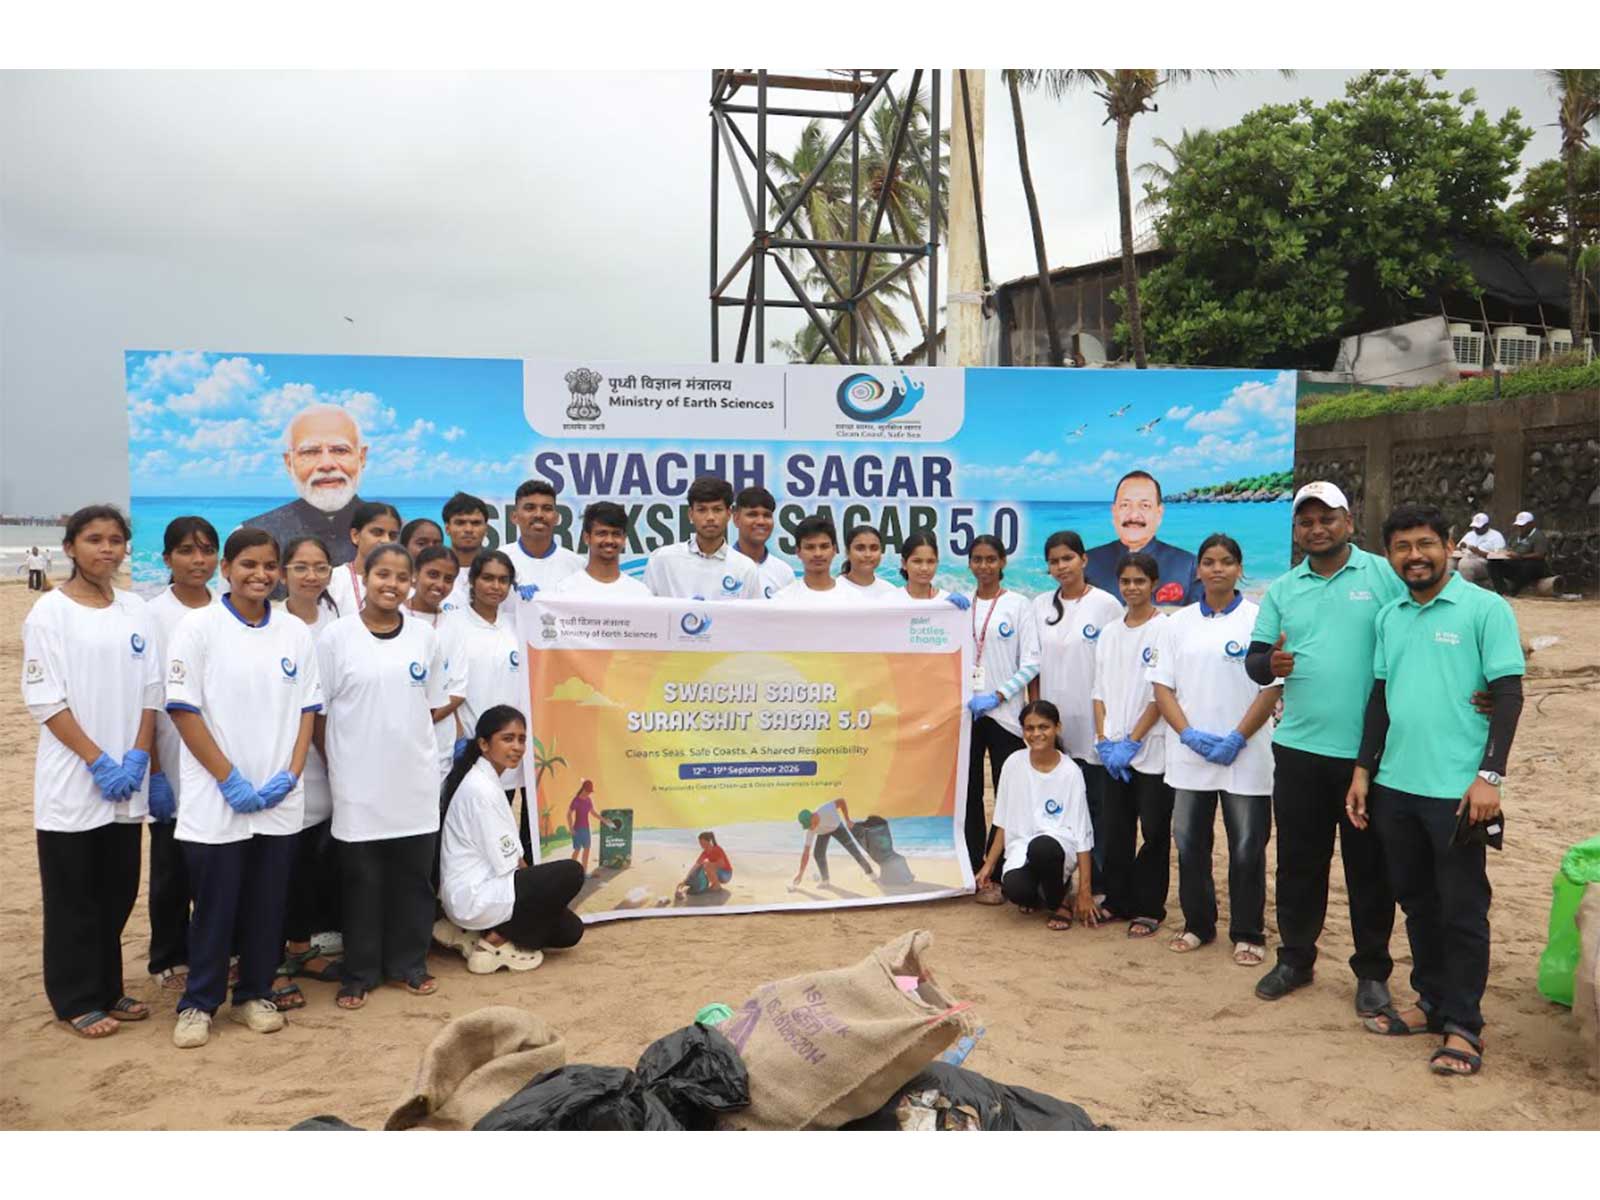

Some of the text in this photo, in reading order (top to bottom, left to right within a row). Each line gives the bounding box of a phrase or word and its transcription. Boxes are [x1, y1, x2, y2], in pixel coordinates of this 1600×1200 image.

[608, 374, 732, 393] पृथ्वी विज्ञान मंत्रालय
[608, 396, 775, 410] Ministry of Earth Sciences
[534, 451, 953, 498] SWACHH SAGAR
[950, 507, 1018, 557] 50
[663, 682, 838, 703] SWACHH SAGAR
[627, 709, 872, 732] SURAKSHIT SAGAR 5.0
[689, 747, 711, 757] Safe
[750, 747, 758, 755] A
[760, 746, 796, 755] Shared
[798, 745, 869, 757] Responsibility
[728, 765, 777, 776] September
